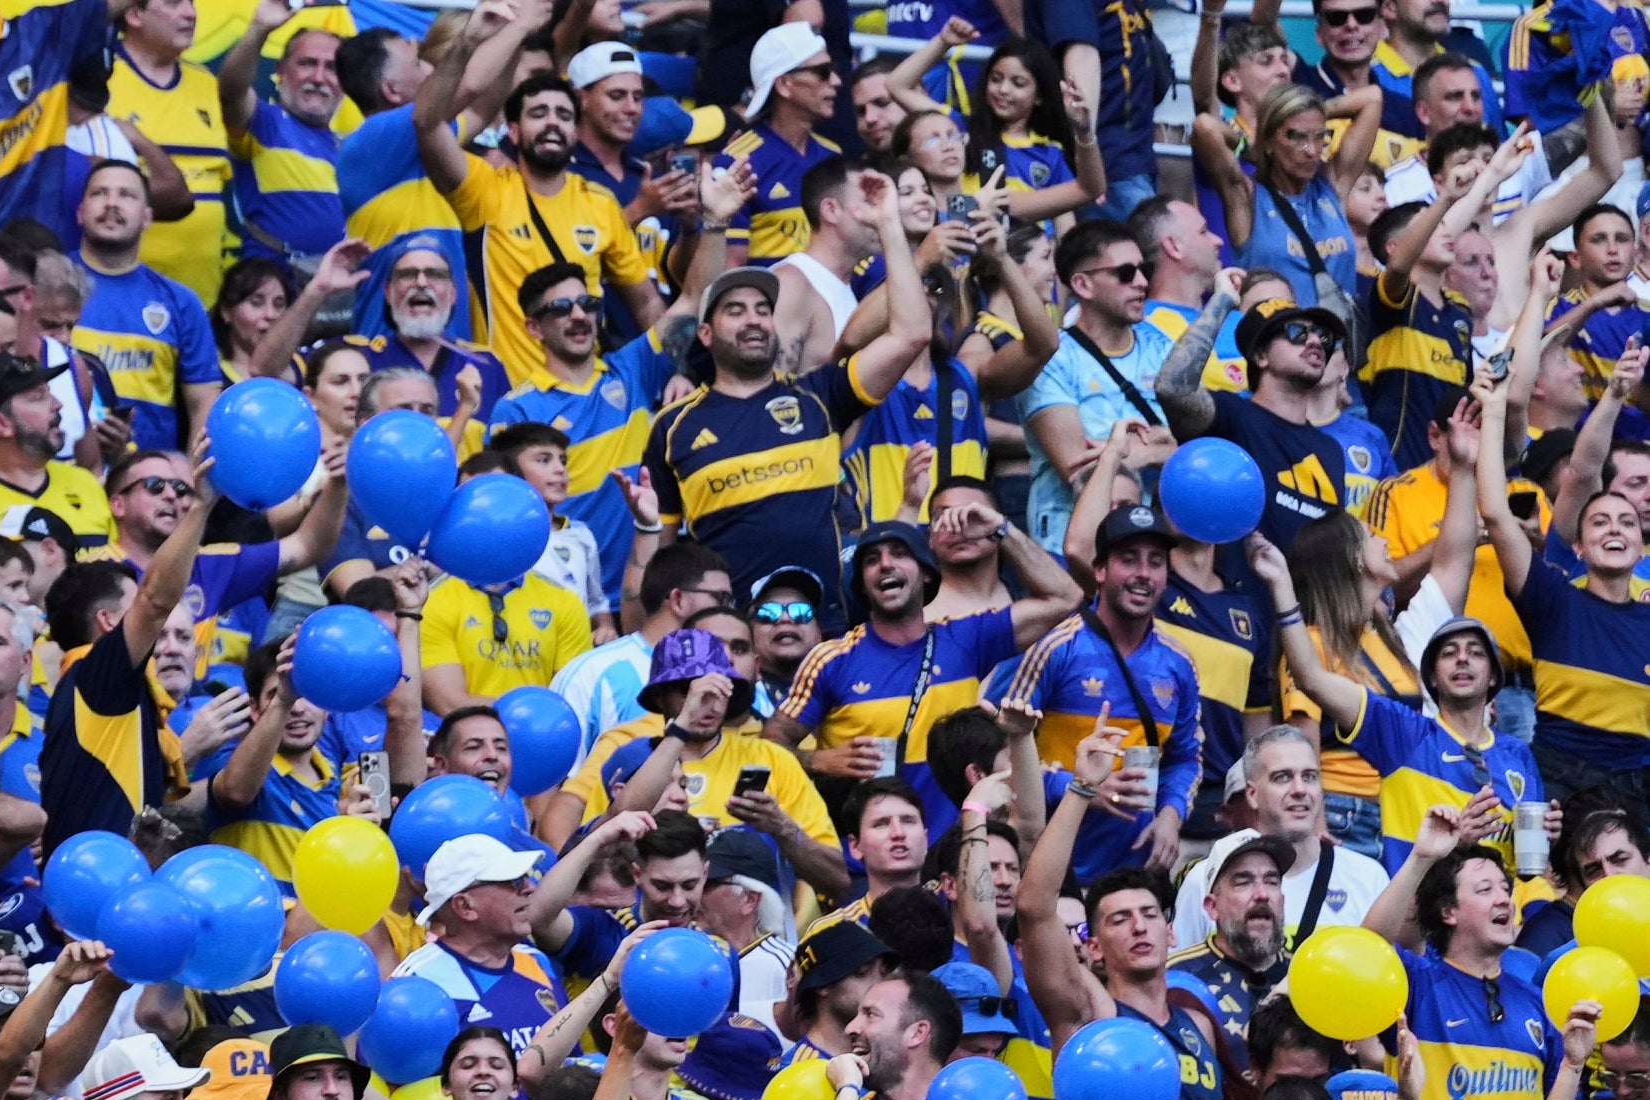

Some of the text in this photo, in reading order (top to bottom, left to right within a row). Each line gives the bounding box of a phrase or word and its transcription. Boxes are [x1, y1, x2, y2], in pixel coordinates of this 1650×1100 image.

[707, 454, 815, 497] betsson
[477, 638, 540, 664] QAAR
[230, 1050, 273, 1077] CA
[1178, 1053, 1215, 1090] BJ
